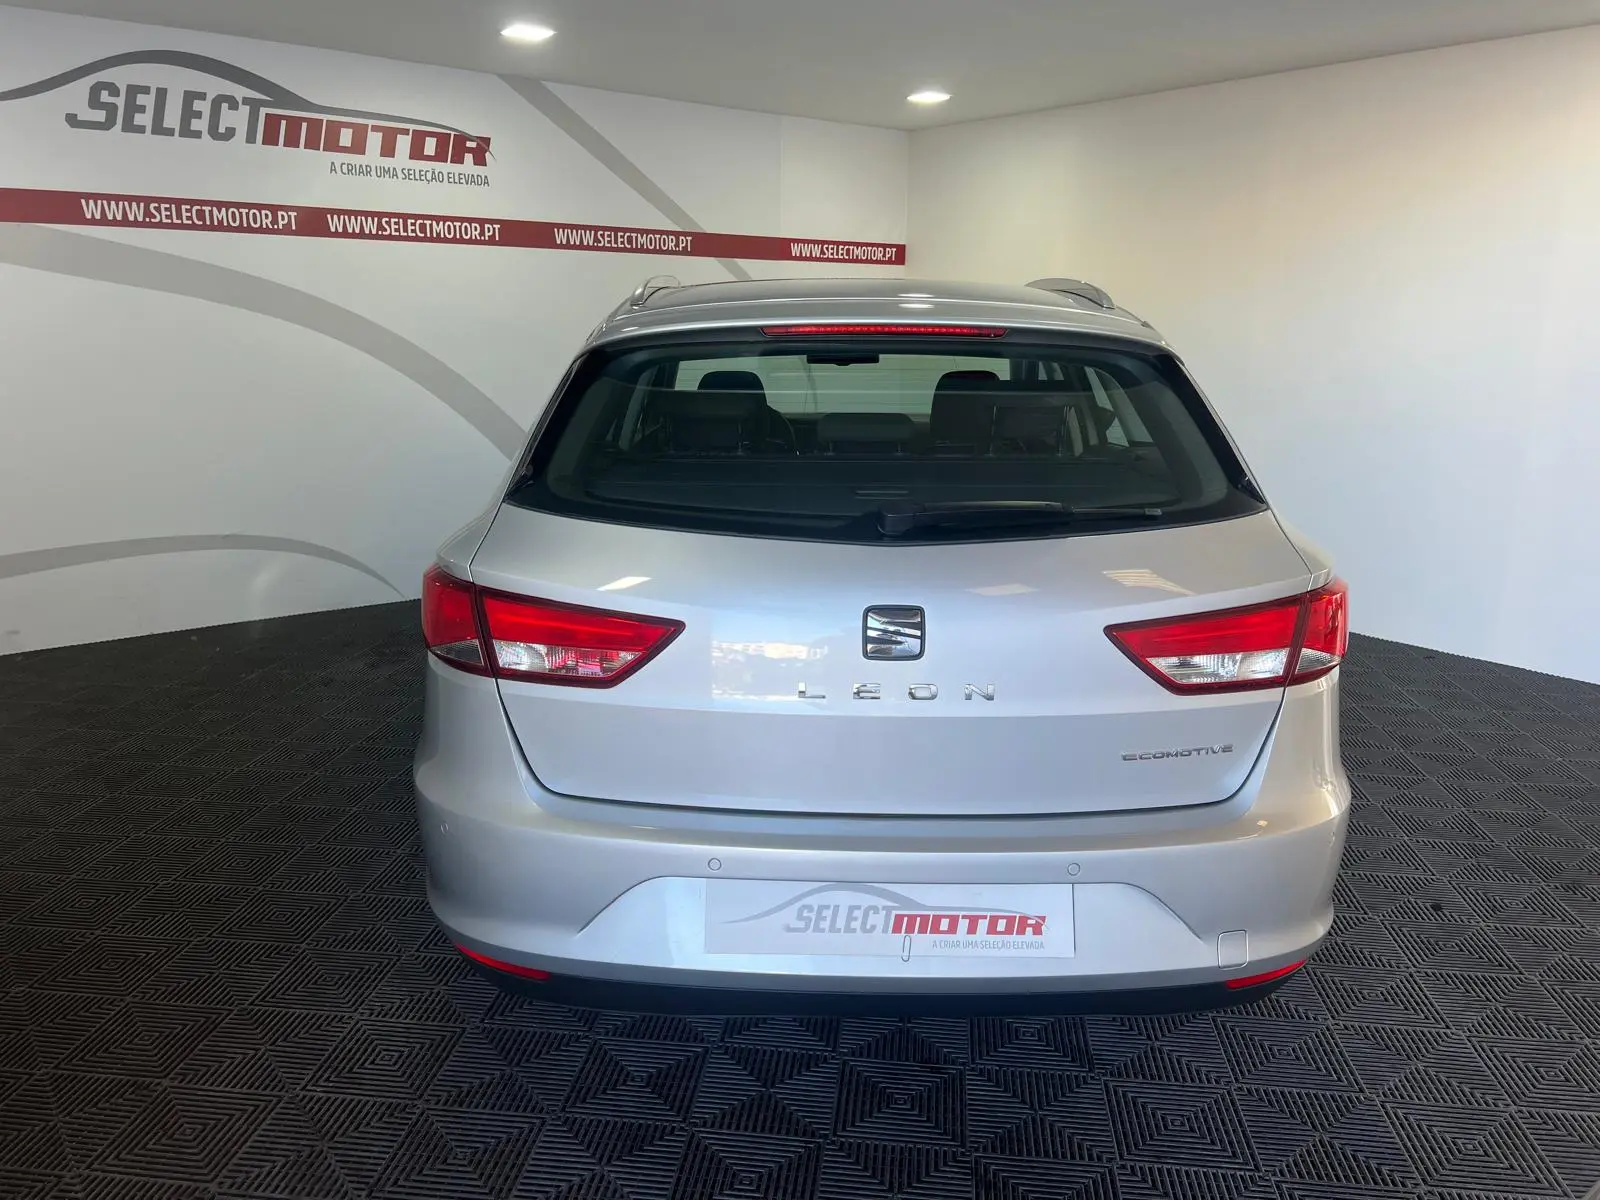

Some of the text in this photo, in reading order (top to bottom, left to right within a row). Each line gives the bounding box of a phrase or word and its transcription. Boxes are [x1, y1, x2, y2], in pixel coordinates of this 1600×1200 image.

[329, 161, 490, 187] A CRIAR UMA SELEÇÃO ELEVADA
[80, 198, 897, 262] WWW.SELECTMOTOR.PT WWW.SELECTMOTOR.PT WWW.SELECTMOTOR.PT WWW.SELECTMOTOR.PT
[797, 682, 996, 701] LEON
[1121, 744, 1234, 762] ECOMOTIVE
[932, 939, 1045, 952] A CRIAR UMA SELEÇÃO ELEVADA
